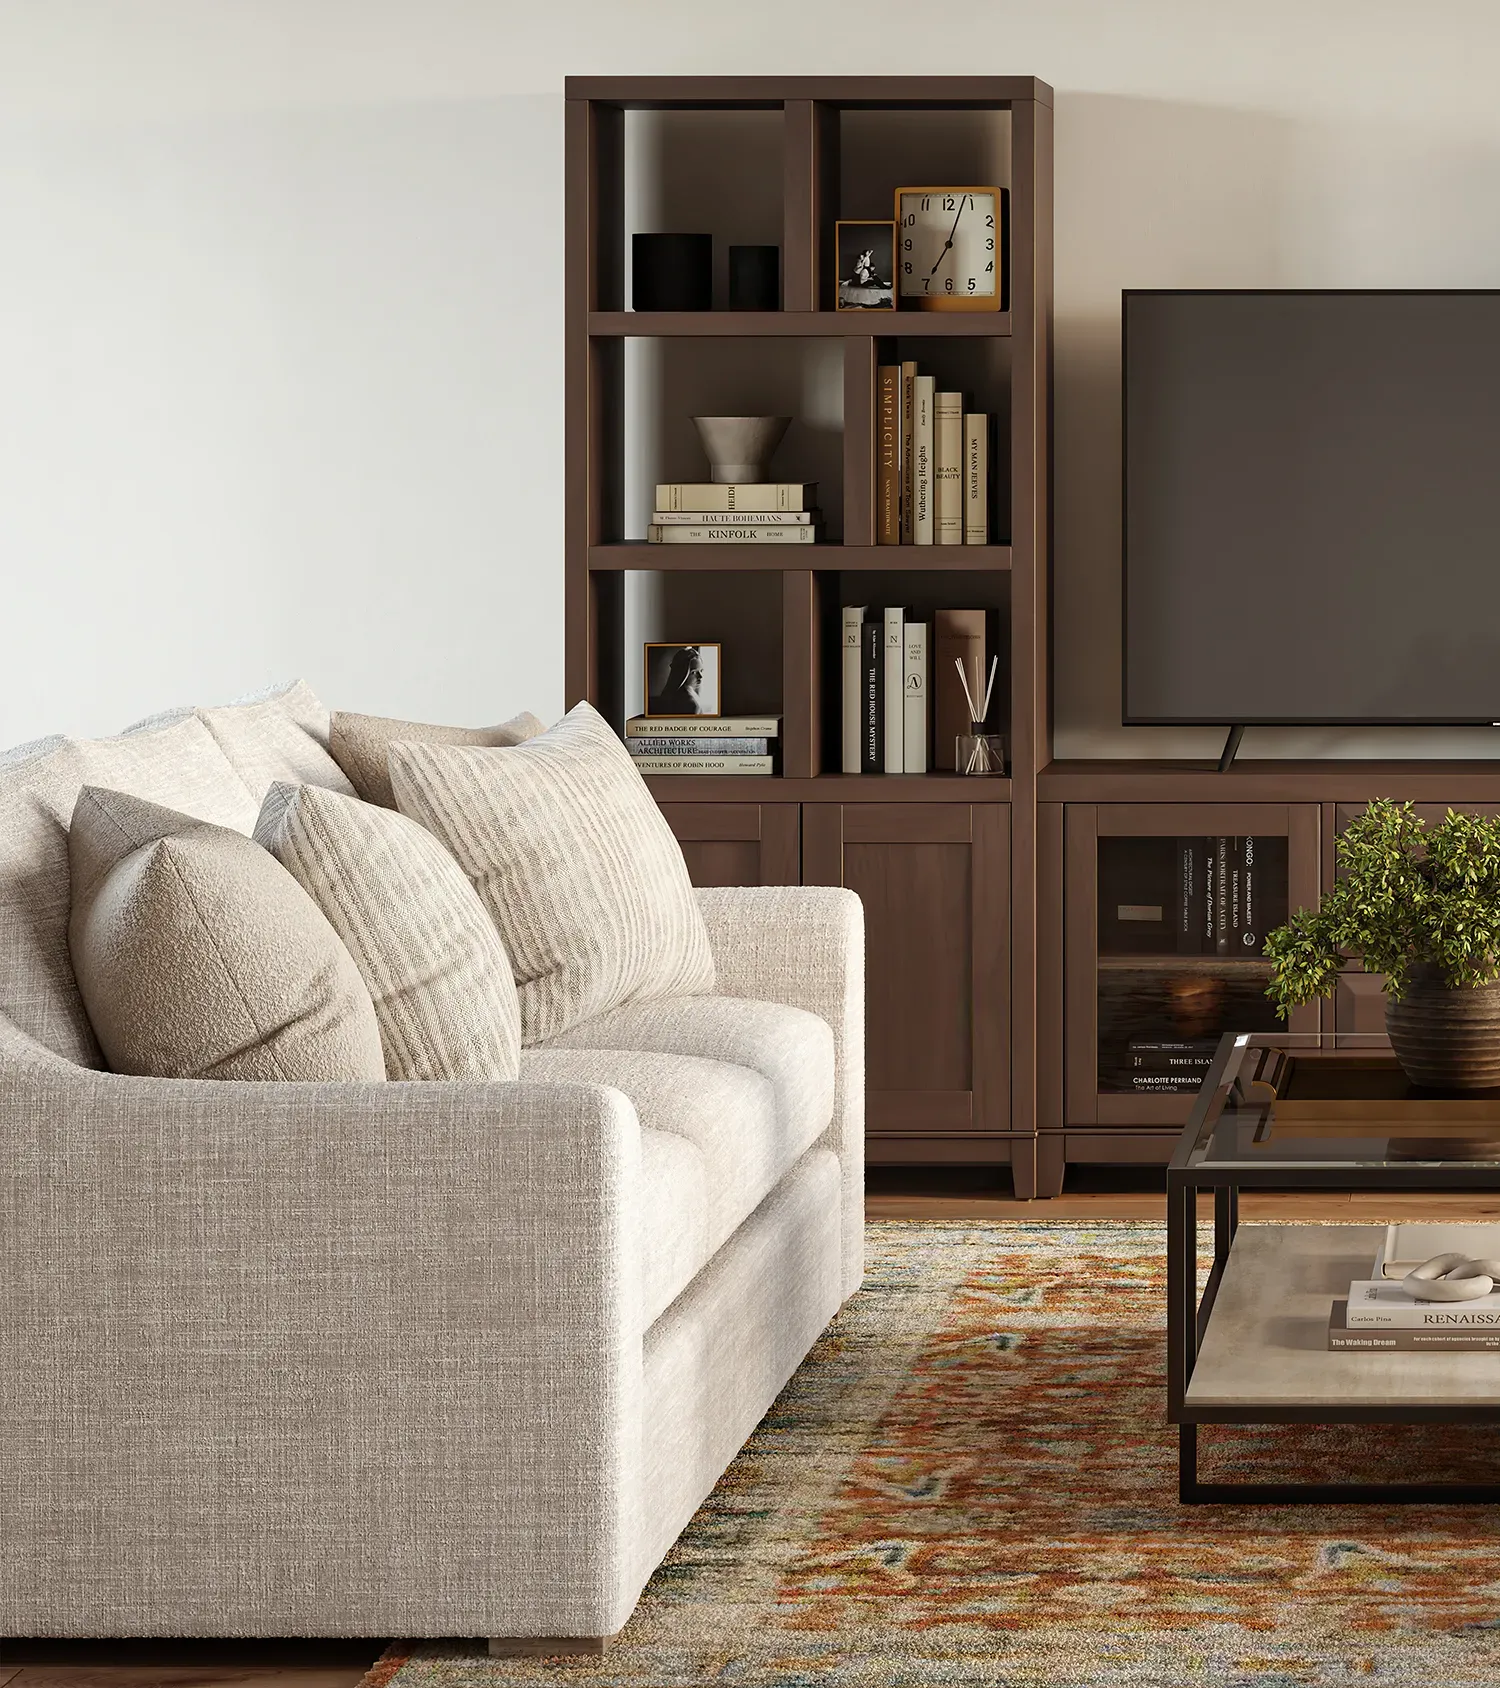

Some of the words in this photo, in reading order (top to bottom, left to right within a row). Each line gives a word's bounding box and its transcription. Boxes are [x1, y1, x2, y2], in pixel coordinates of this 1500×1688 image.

[942, 198, 955, 211] 12
[903, 213, 915, 228] 10
[985, 214, 994, 229] 2
[904, 239, 912, 251] 9
[985, 238, 994, 251] 3
[904, 261, 913, 275] 8
[984, 260, 994, 273] 4
[921, 278, 931, 291] 7
[944, 278, 953, 291] 6
[967, 278, 976, 291] 5
[884, 378, 892, 468] SIMPLICITY
[972, 438, 978, 450] MY
[919, 445, 928, 476] Heights
[919, 479, 928, 521] Wuthering
[708, 530, 757, 539] KINFOLK
[848, 635, 856, 643] N
[890, 635, 898, 643] N
